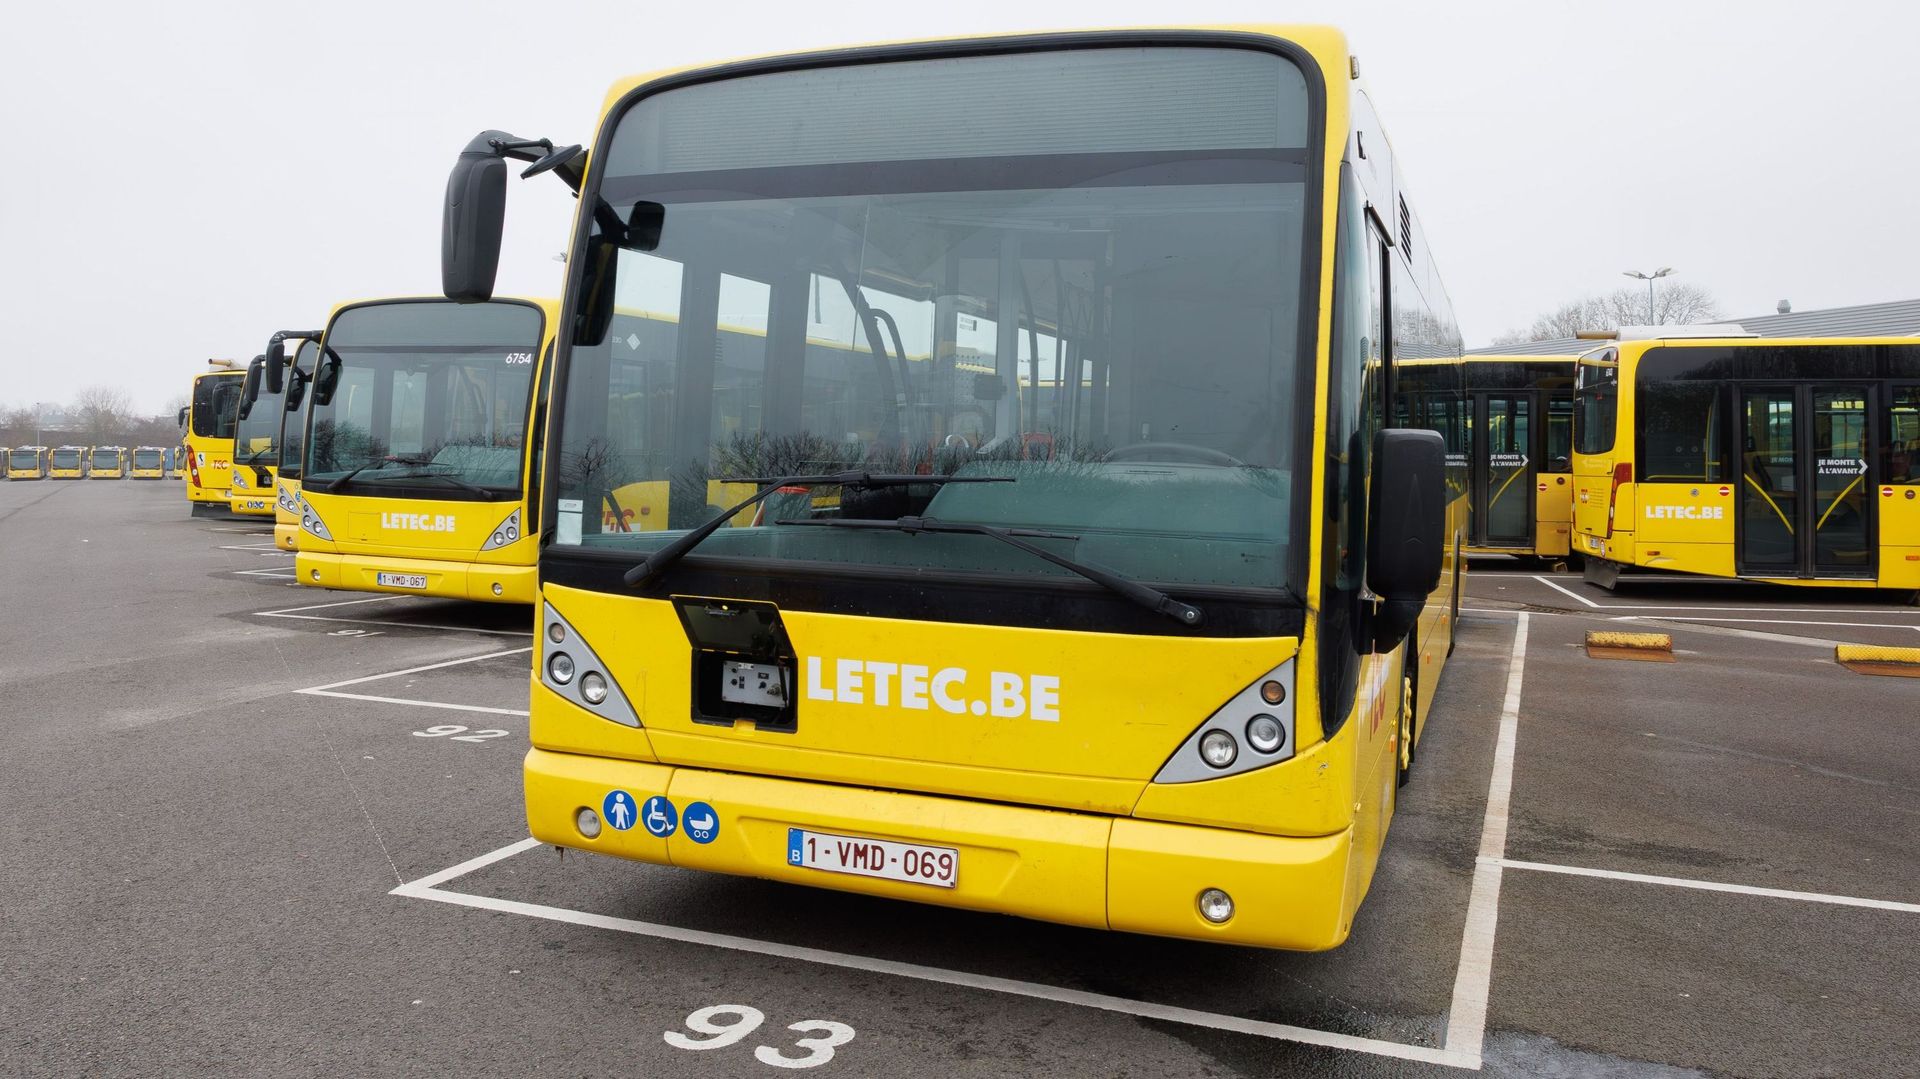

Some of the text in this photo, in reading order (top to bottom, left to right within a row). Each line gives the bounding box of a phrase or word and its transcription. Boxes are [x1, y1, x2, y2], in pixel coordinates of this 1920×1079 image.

[505, 352, 532, 364] 6754
[1818, 459, 1826, 467] JE
[1646, 505, 1723, 520] LETEC.BE
[382, 512, 456, 533] LETEC.BE
[382, 574, 426, 586] 1-VMD-067
[807, 656, 1060, 722] LETEC.BE
[412, 724, 510, 743] 92
[791, 837, 953, 881] B 1-VMD-069
[663, 1004, 856, 1069] 93
